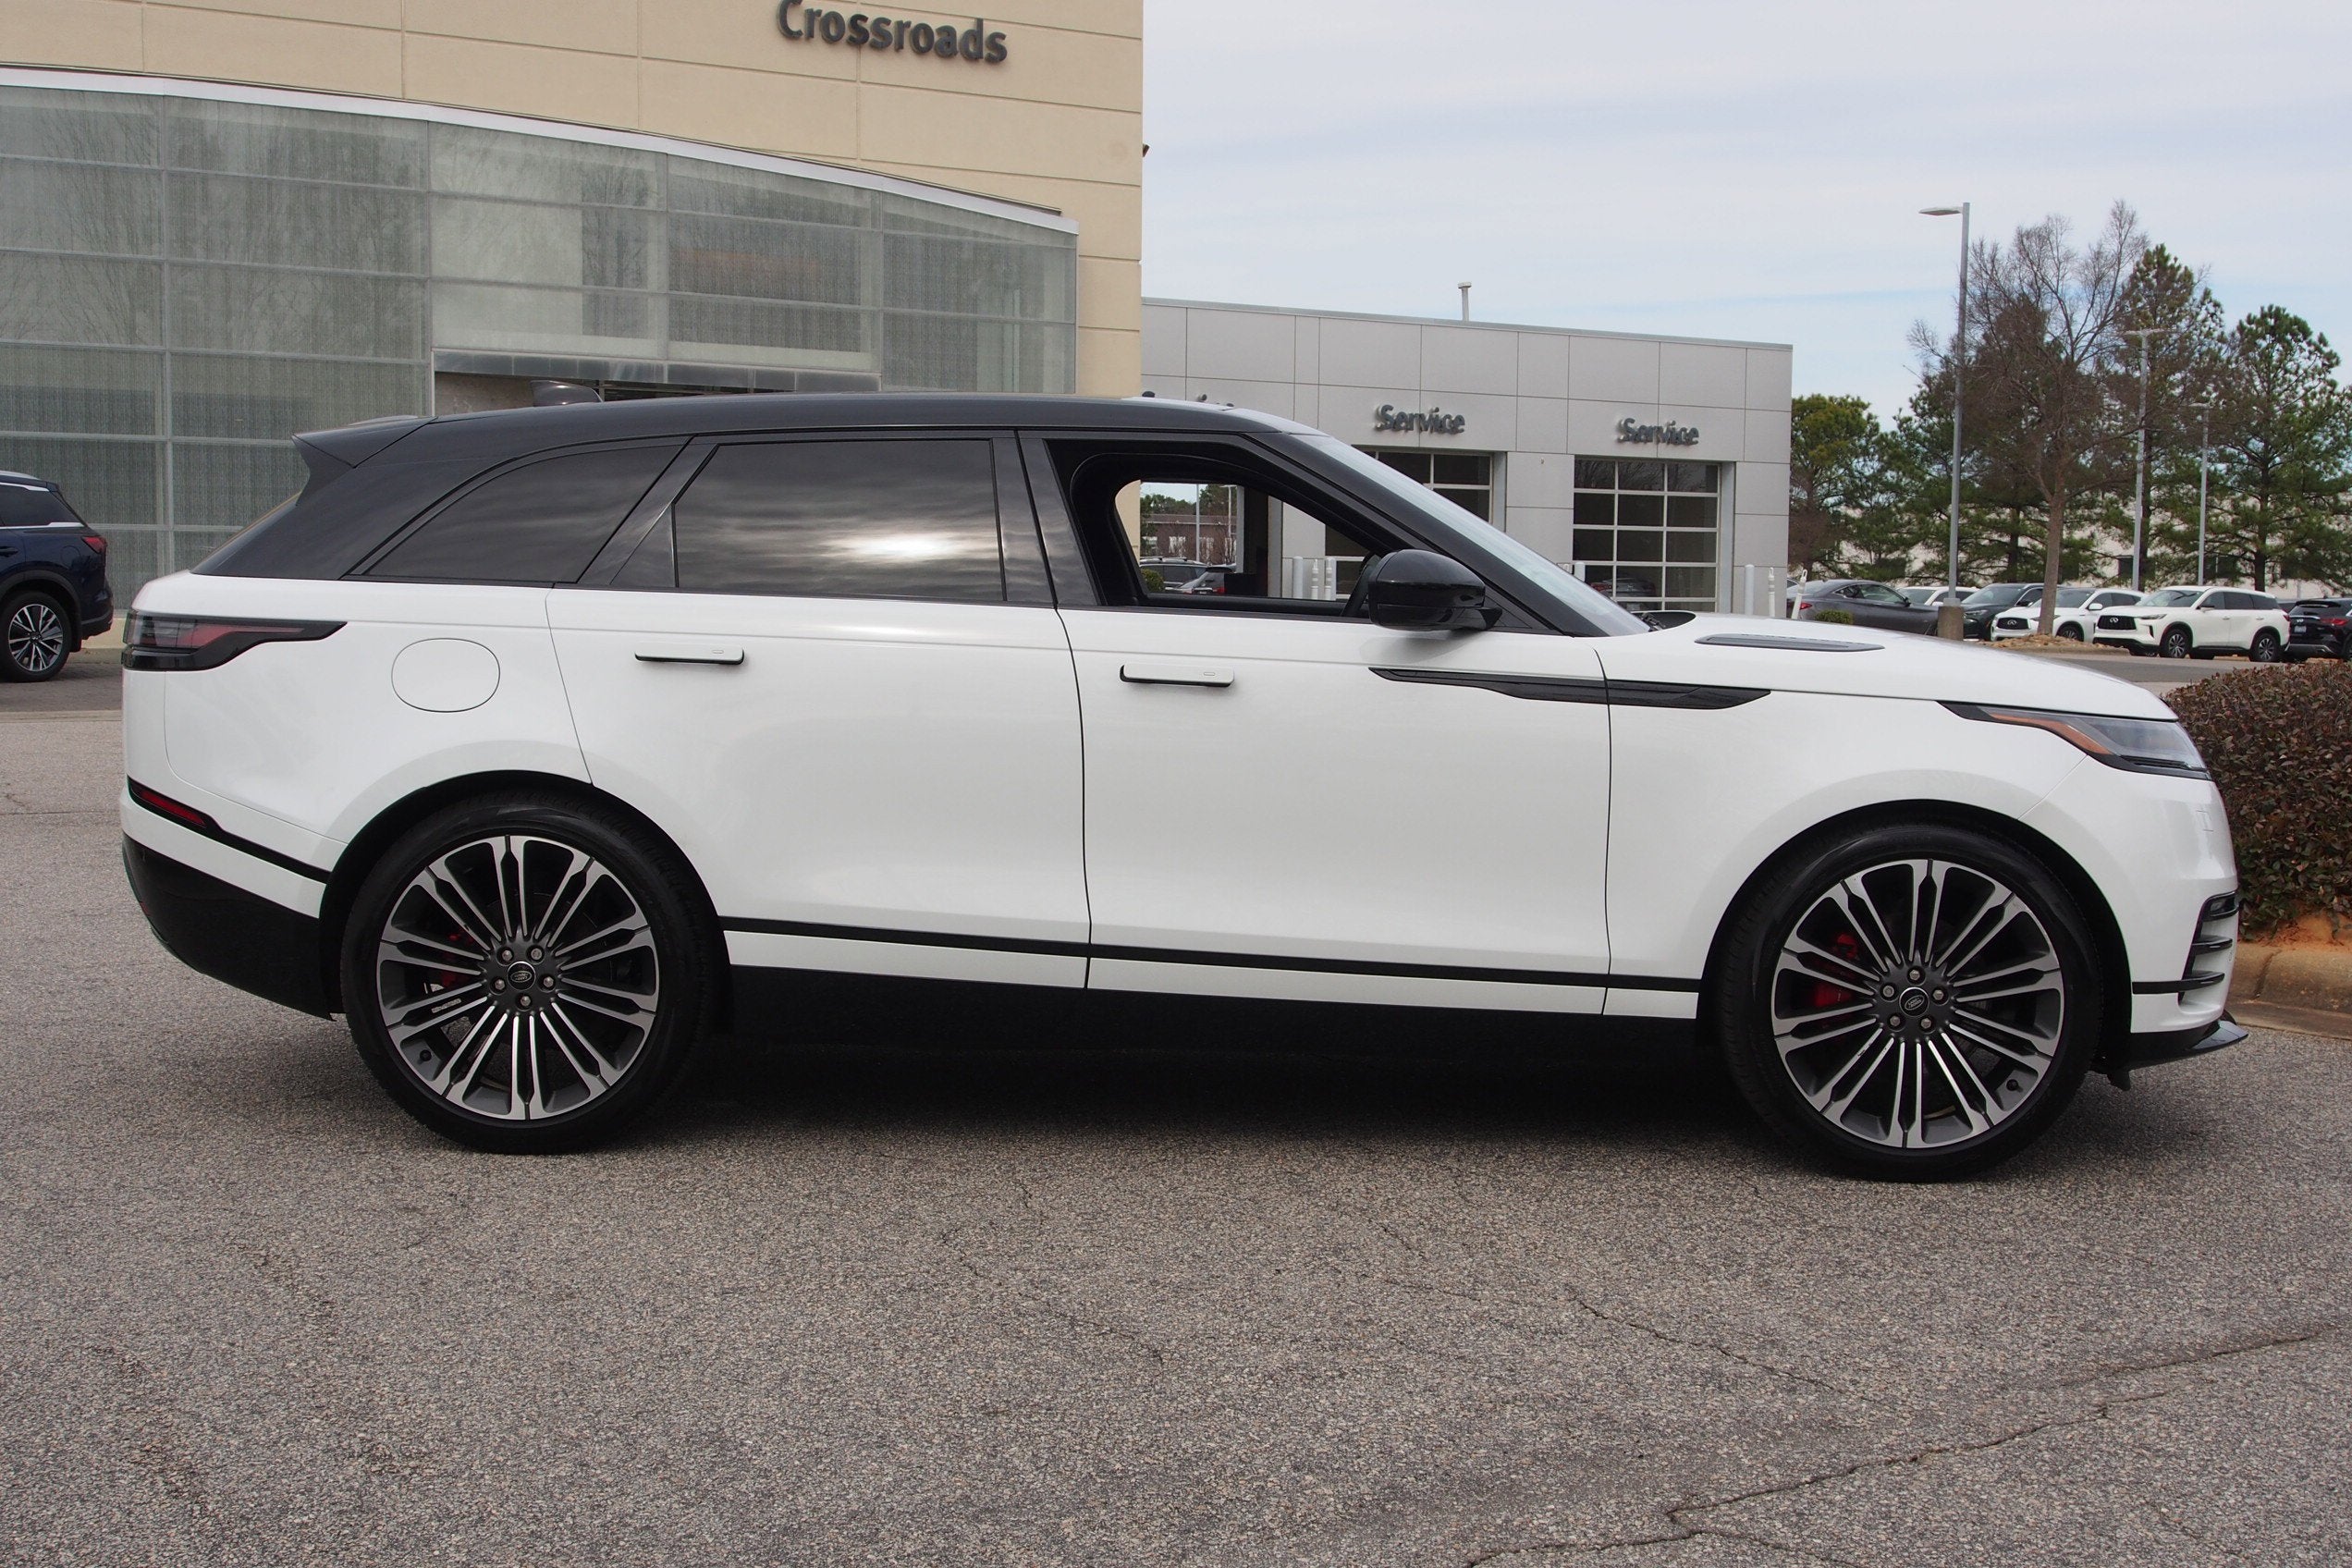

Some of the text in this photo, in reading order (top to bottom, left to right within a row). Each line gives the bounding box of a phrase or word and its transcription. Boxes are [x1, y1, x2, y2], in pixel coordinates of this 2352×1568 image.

[777, 0, 1008, 62] Crossroads
[1376, 404, 1465, 435] Service
[1617, 418, 1699, 446] Service
